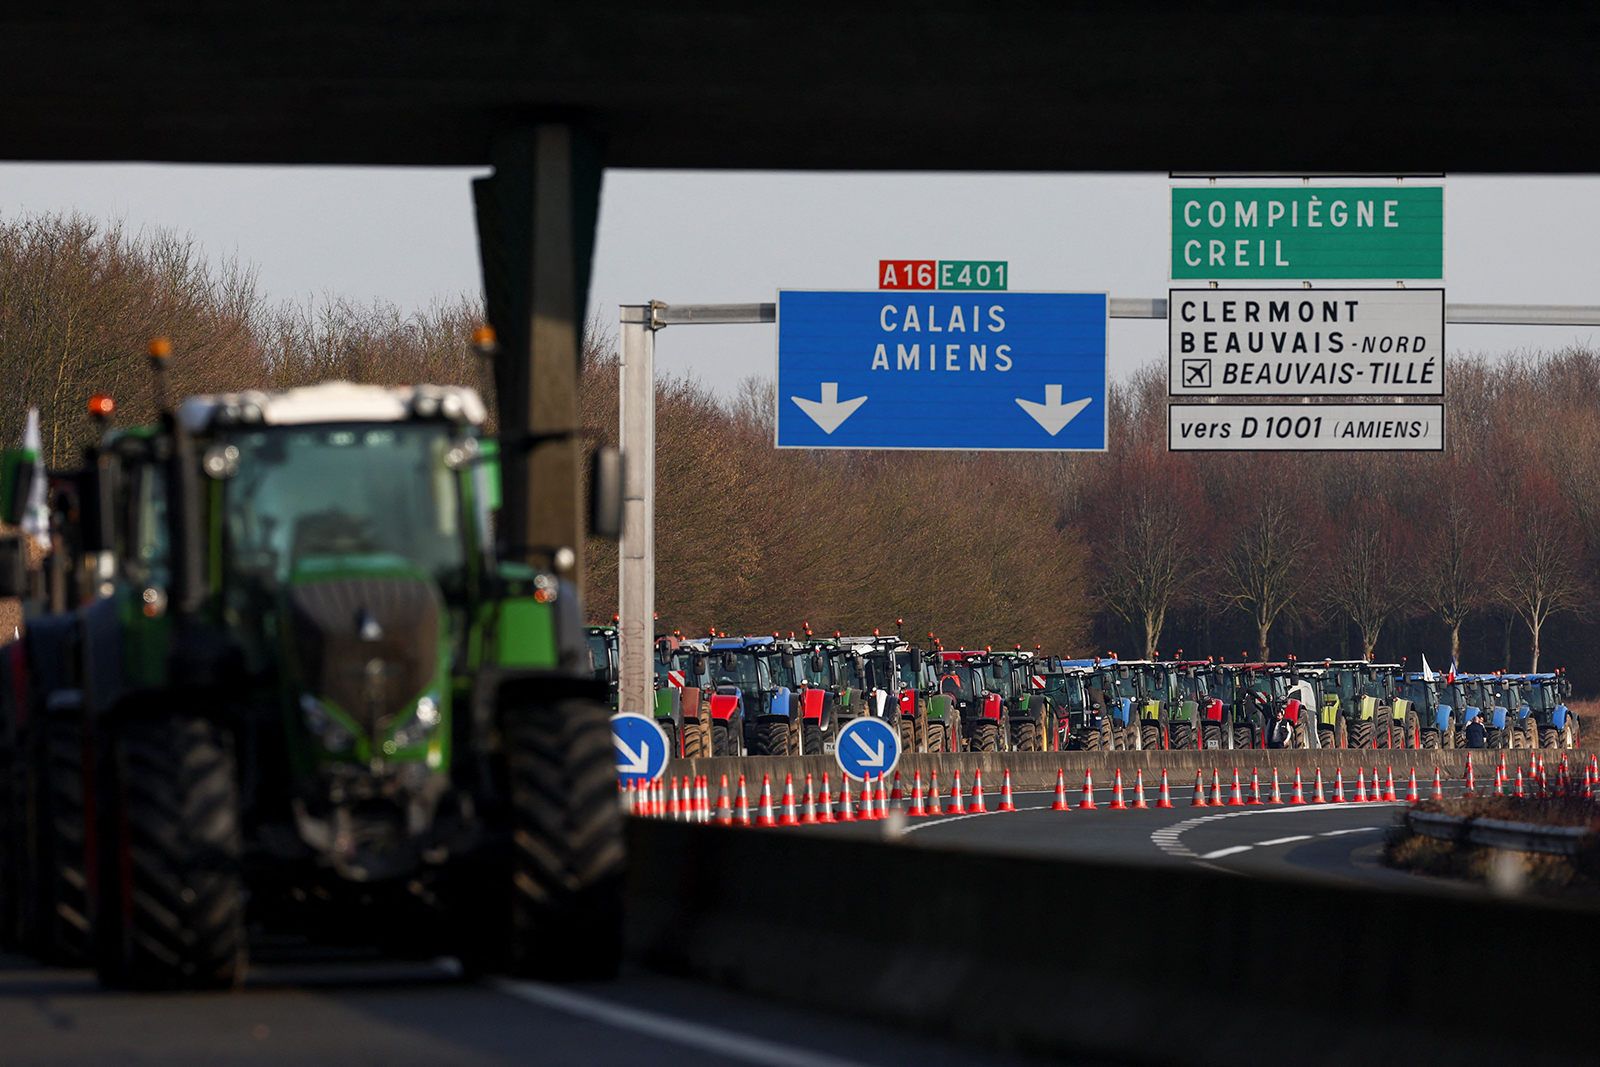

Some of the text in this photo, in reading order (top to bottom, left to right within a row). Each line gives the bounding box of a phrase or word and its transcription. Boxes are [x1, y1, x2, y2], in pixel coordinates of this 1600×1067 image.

[1184, 195, 1399, 228] COMPIÈGNE
[1184, 239, 1290, 267] CREIL
[882, 263, 932, 287] A16
[942, 264, 1004, 287] E401
[880, 304, 1006, 333] CALAIS
[1181, 300, 1359, 323] CLERMONT
[871, 343, 1013, 372] AMIENS
[1222, 356, 1435, 385] BEAUVAIS-TILLÉ
[1181, 421, 1232, 439] vers
[1334, 420, 1429, 439] (AMIENS)
